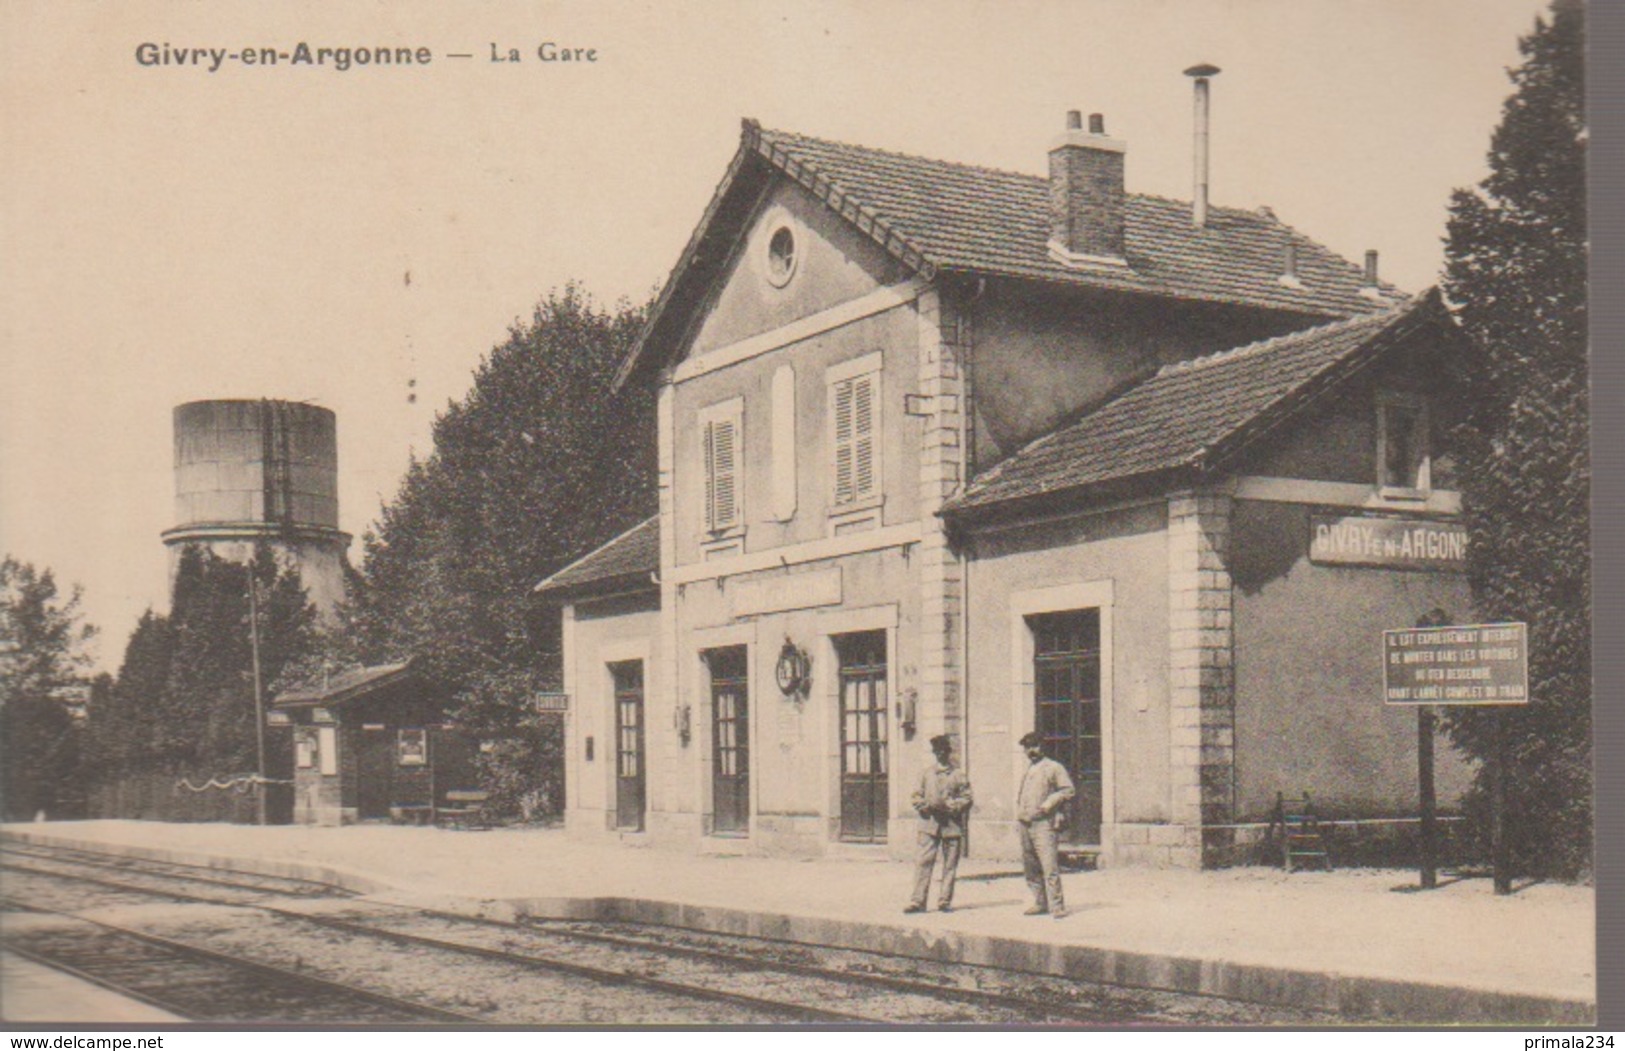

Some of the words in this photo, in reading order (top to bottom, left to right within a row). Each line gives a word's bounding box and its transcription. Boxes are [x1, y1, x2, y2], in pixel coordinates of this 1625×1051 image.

[135, 42, 432, 72] Givry-en-Argonne
[490, 42, 521, 63] La
[537, 42, 598, 62] Gare
